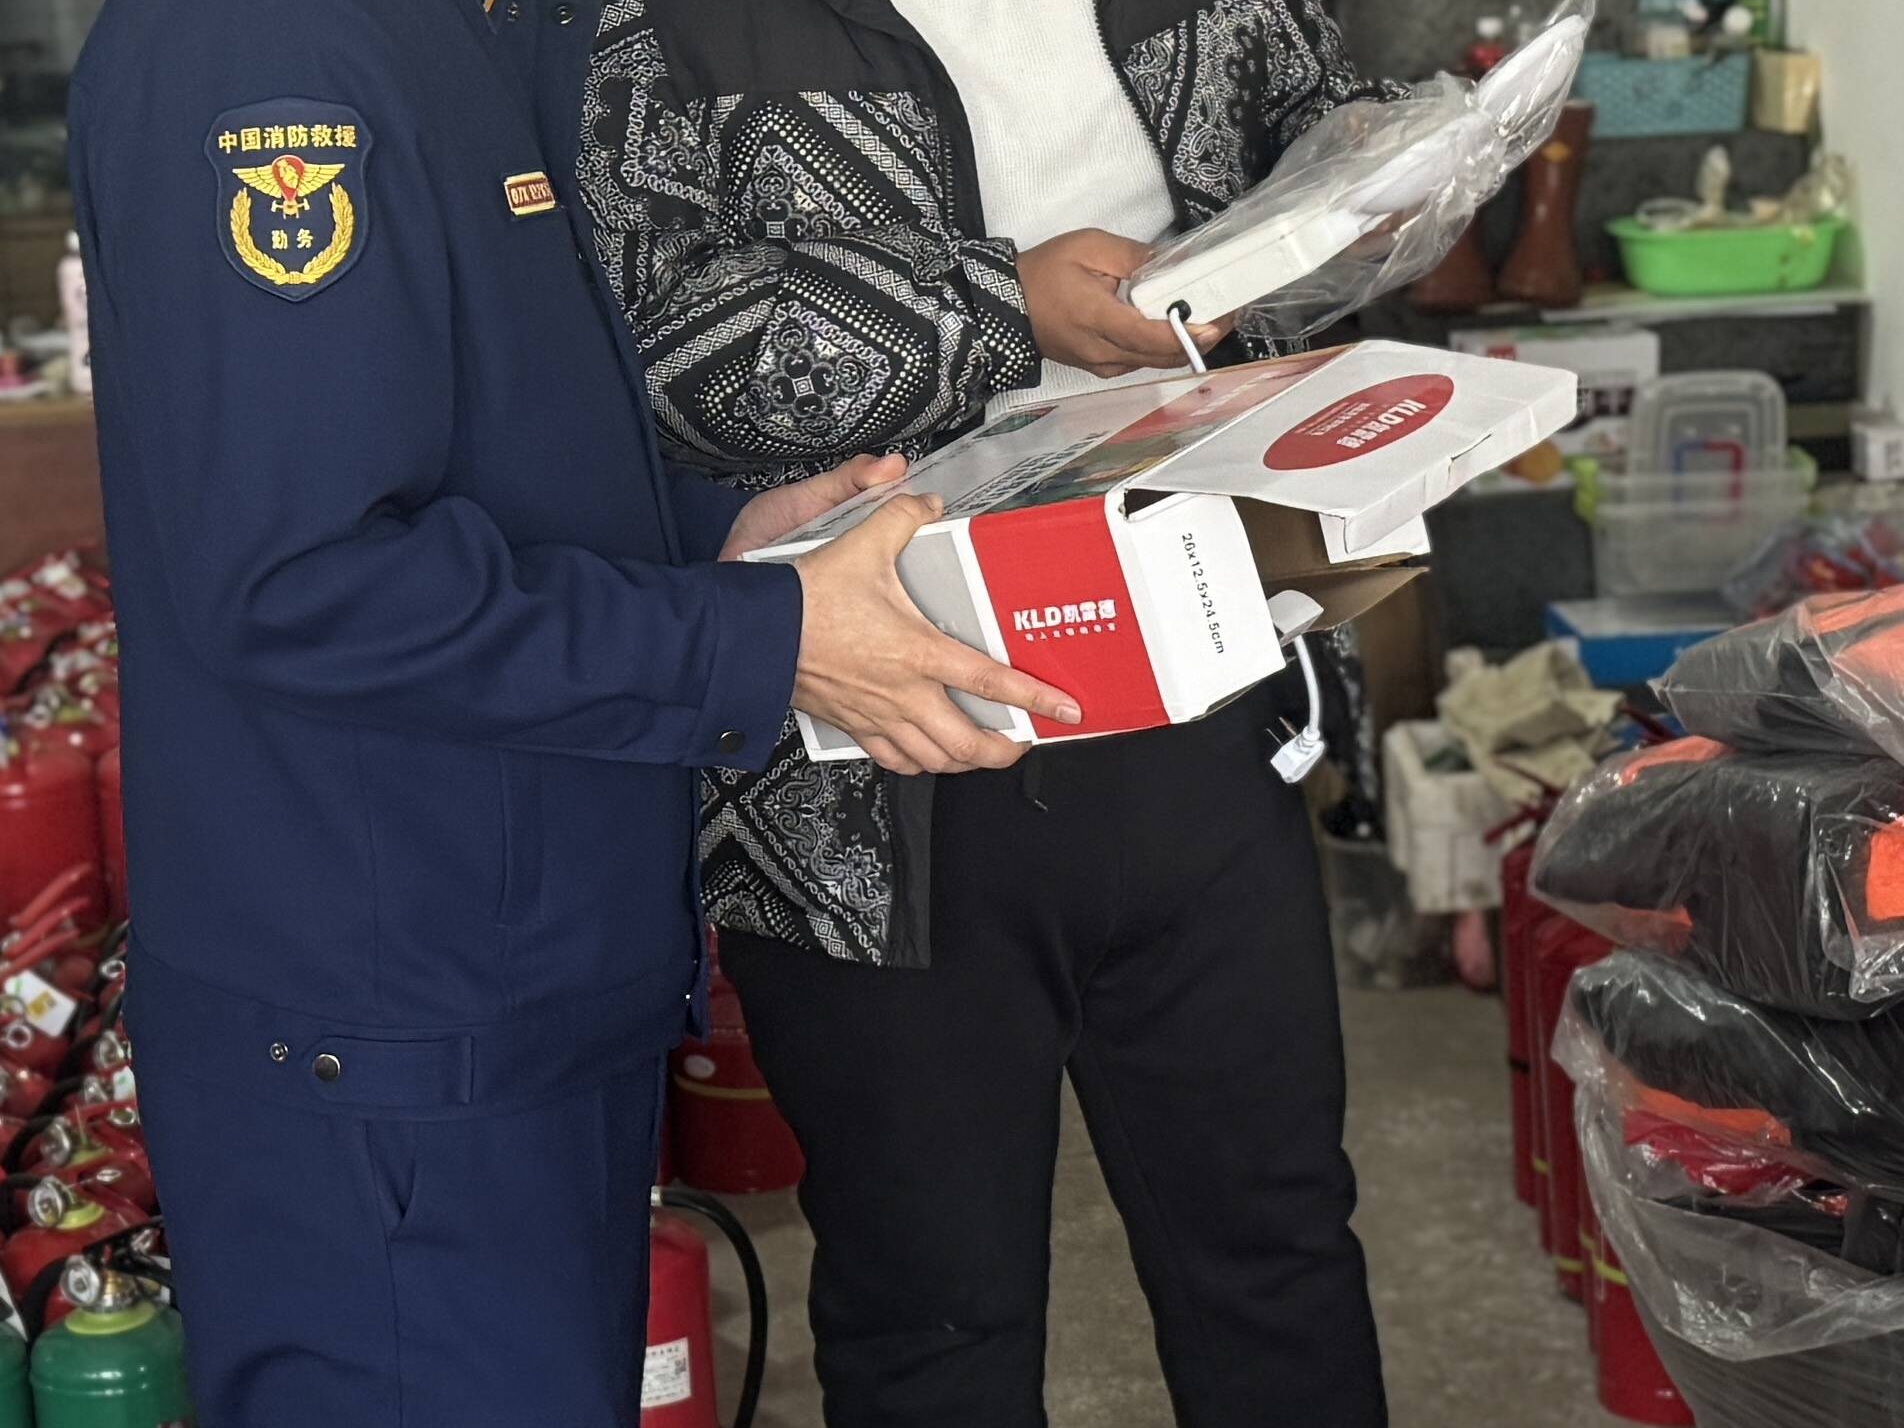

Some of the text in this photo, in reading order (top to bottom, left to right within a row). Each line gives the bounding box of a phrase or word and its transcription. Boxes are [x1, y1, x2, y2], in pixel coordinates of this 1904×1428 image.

[217, 122, 358, 155] 中国消防救援
[270, 227, 314, 251] 勤务
